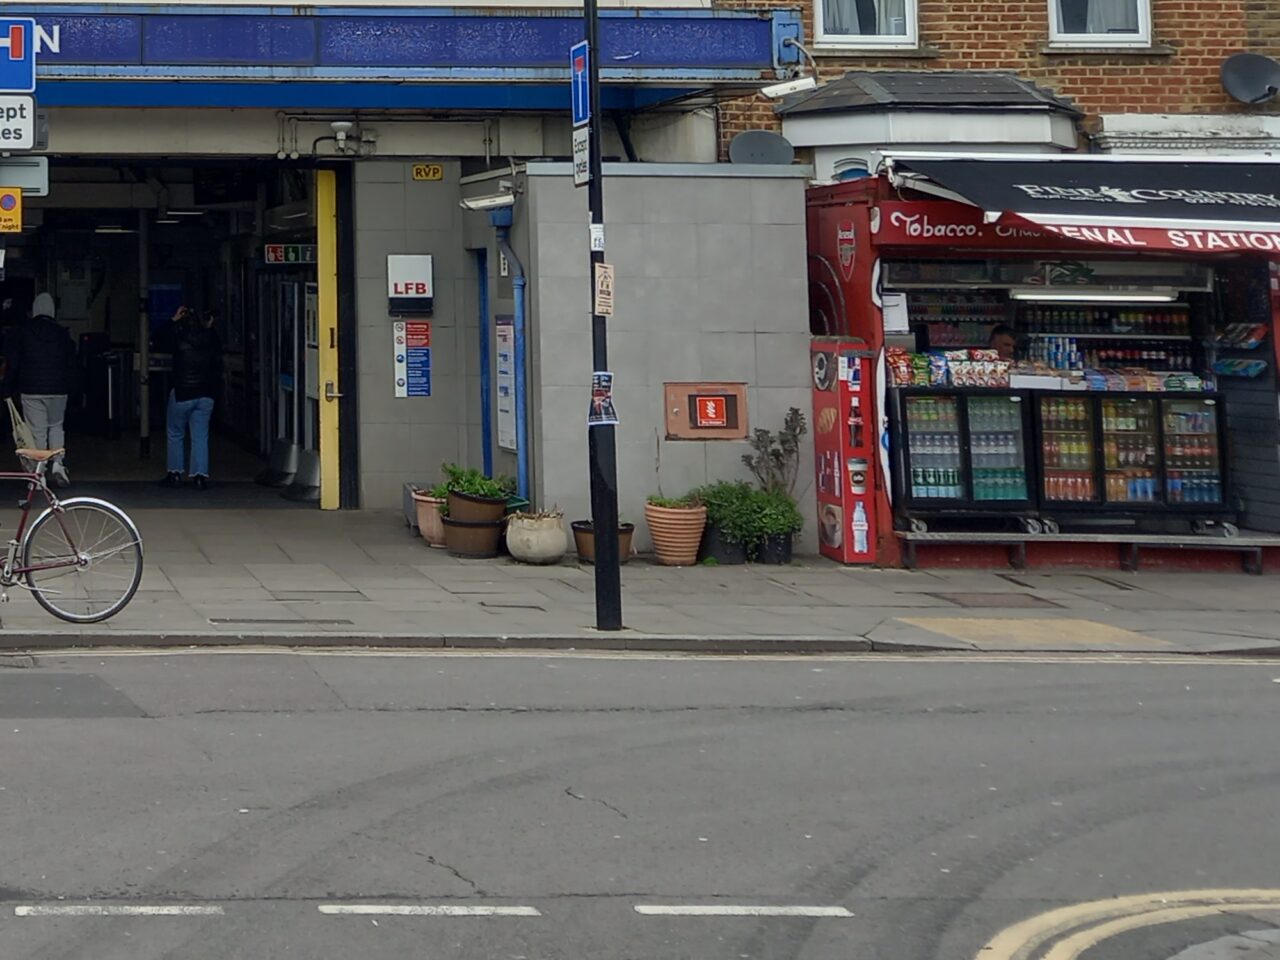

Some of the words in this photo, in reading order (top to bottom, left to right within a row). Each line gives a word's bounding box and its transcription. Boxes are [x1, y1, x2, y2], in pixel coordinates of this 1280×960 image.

[415, 167, 440, 178] RVP
[890, 211, 983, 238] Tobacco.
[393, 282, 427, 295] LFB
